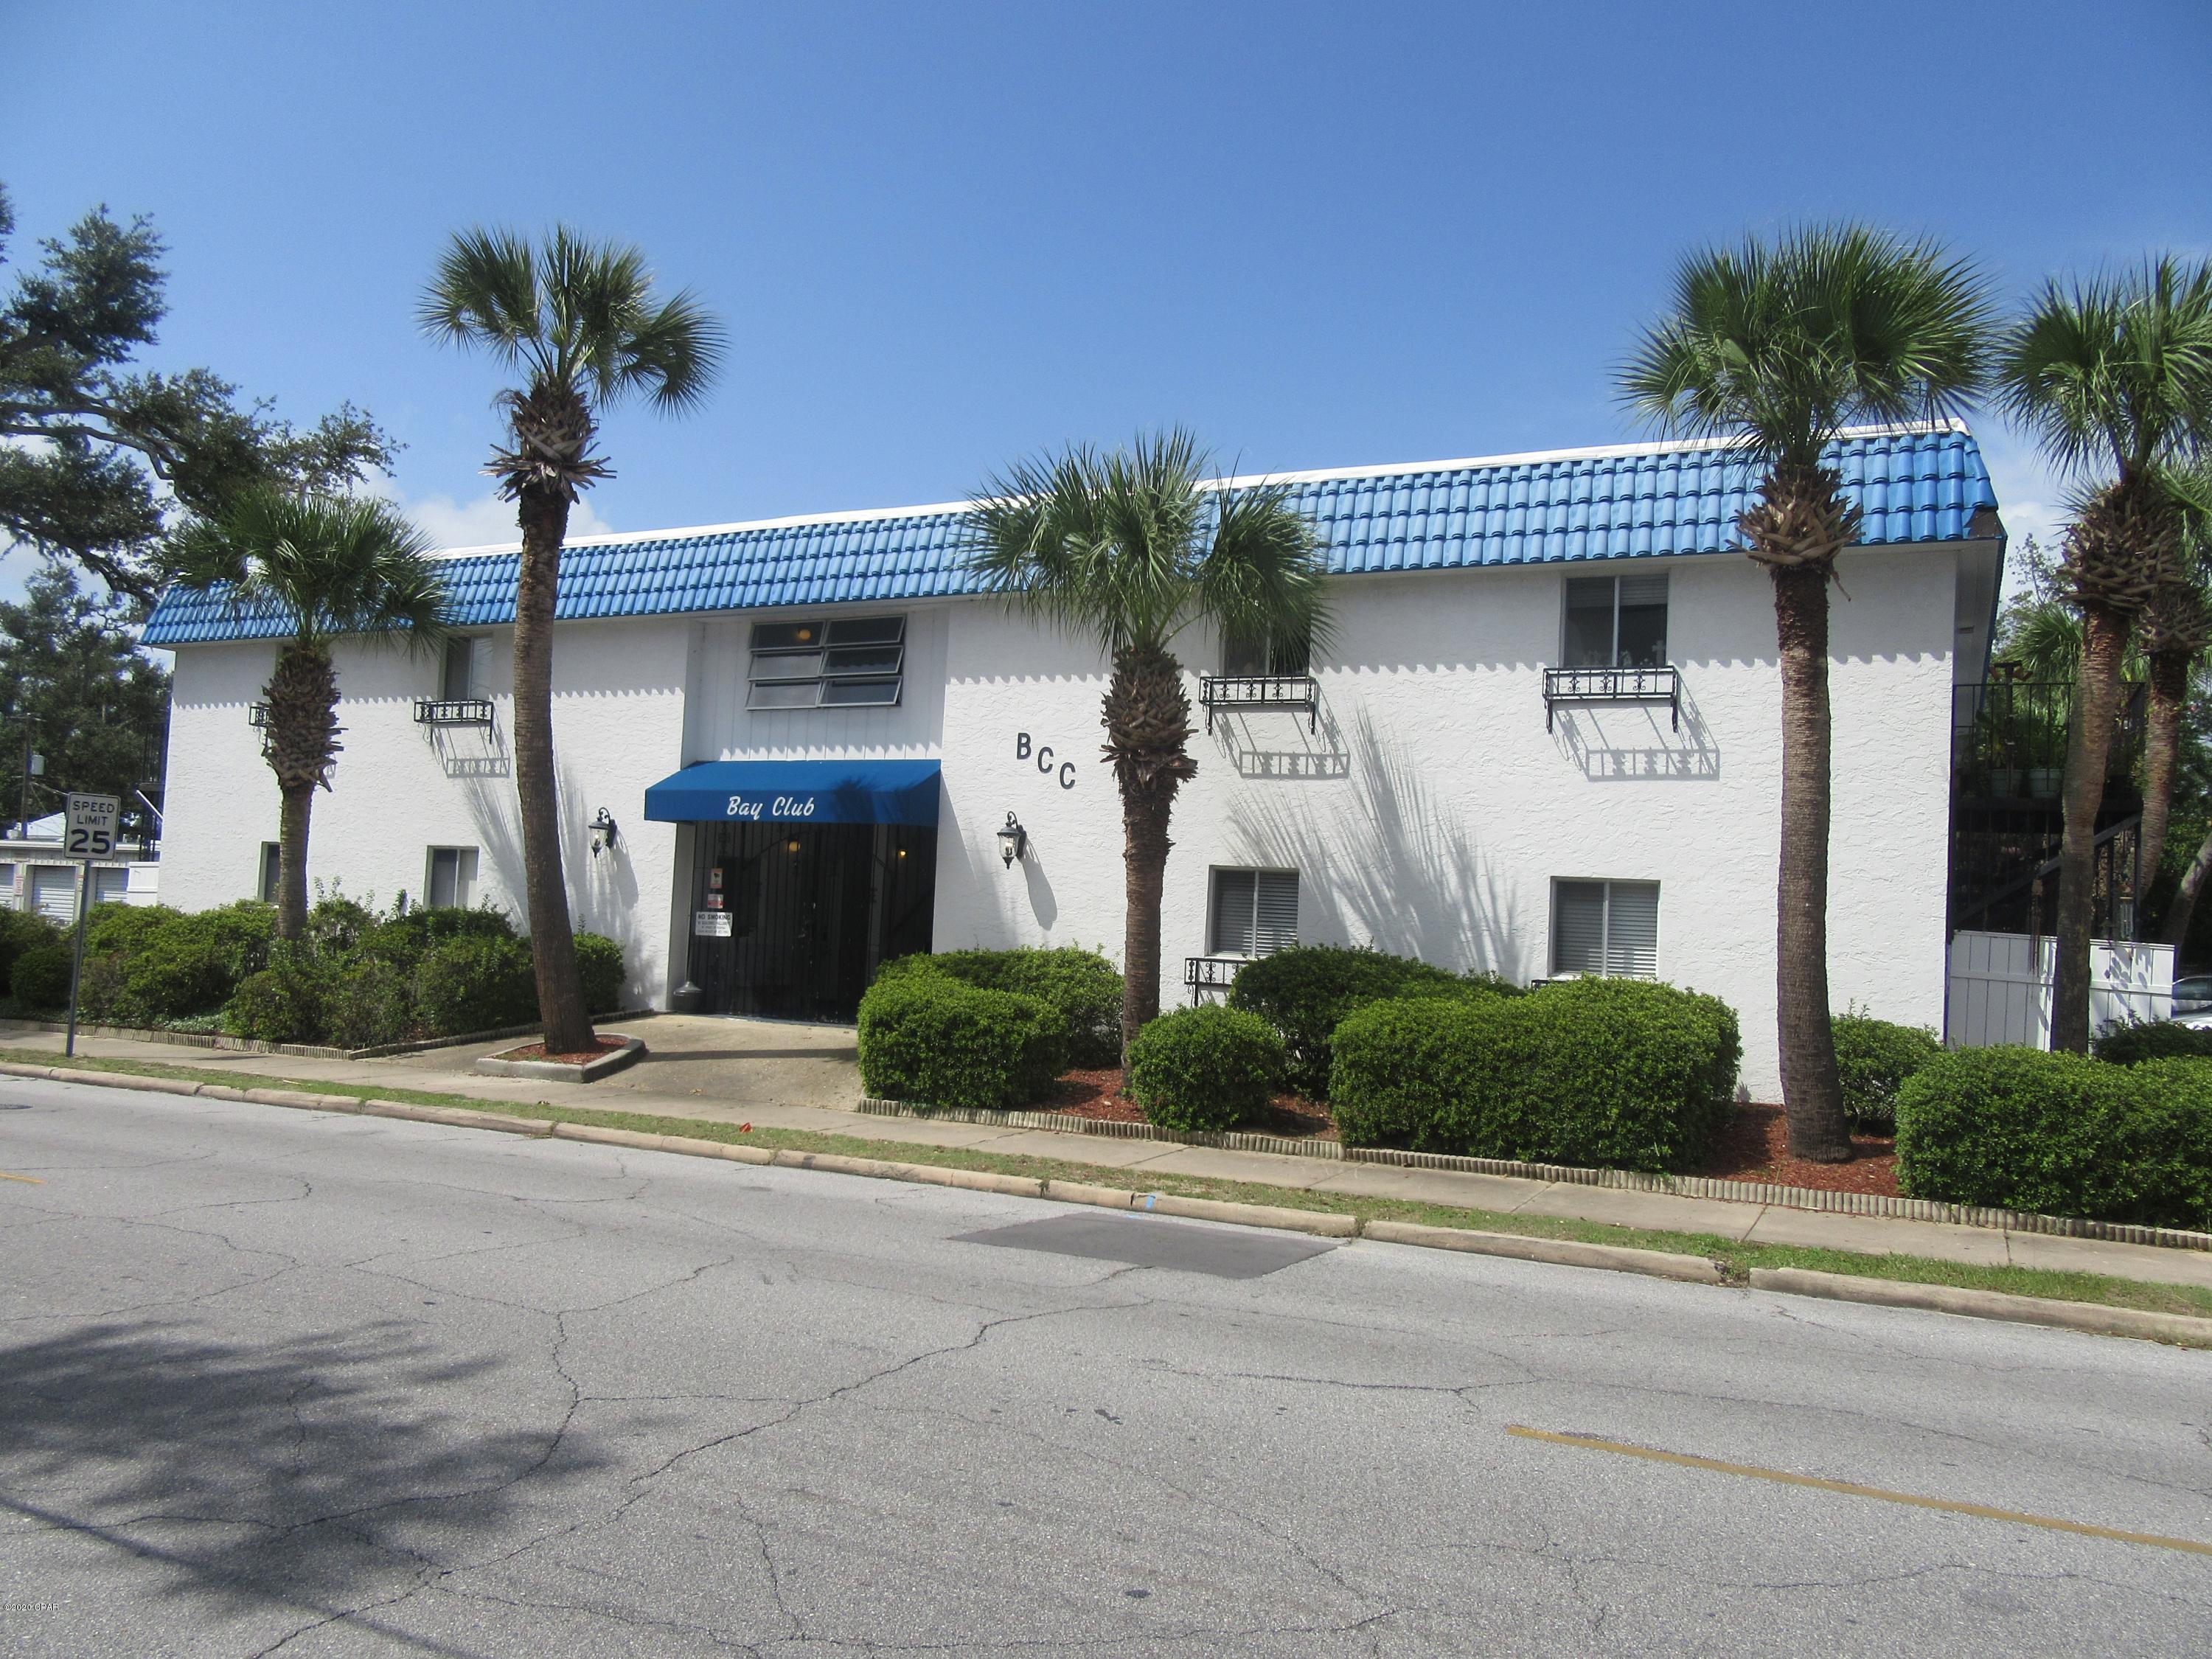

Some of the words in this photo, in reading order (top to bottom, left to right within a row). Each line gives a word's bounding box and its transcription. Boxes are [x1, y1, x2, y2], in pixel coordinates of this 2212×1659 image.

[1017, 733, 1076, 790] BCC
[73, 801, 115, 813] SPEED
[726, 796, 763, 820] Bay
[772, 796, 815, 816] Club
[77, 814, 108, 826] LIMIT
[69, 828, 110, 855] 25
